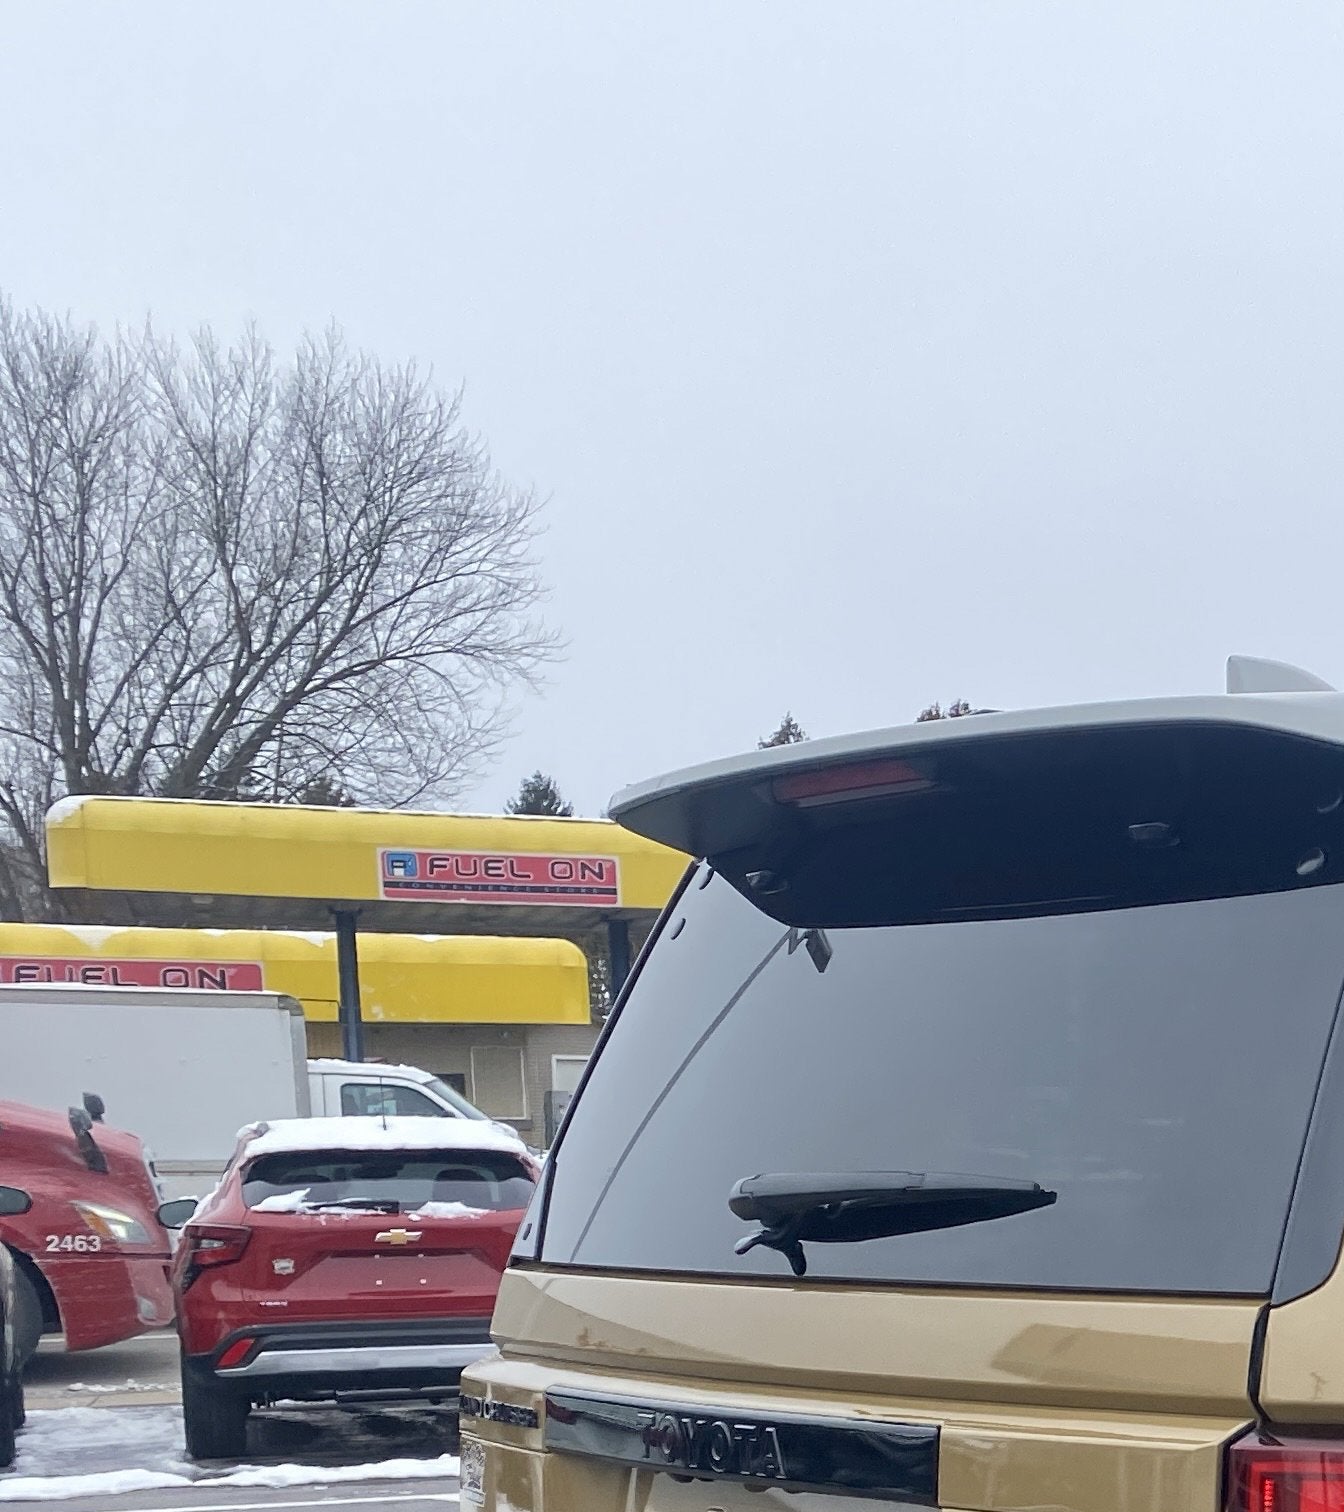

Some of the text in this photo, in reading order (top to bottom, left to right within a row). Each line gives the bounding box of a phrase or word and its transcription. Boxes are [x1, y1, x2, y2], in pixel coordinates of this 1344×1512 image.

[427, 856, 605, 881] FUEL ON
[14, 964, 228, 990] FUEL ON
[46, 1234, 102, 1252] 2463
[637, 1411, 788, 1480] TOYOTA
